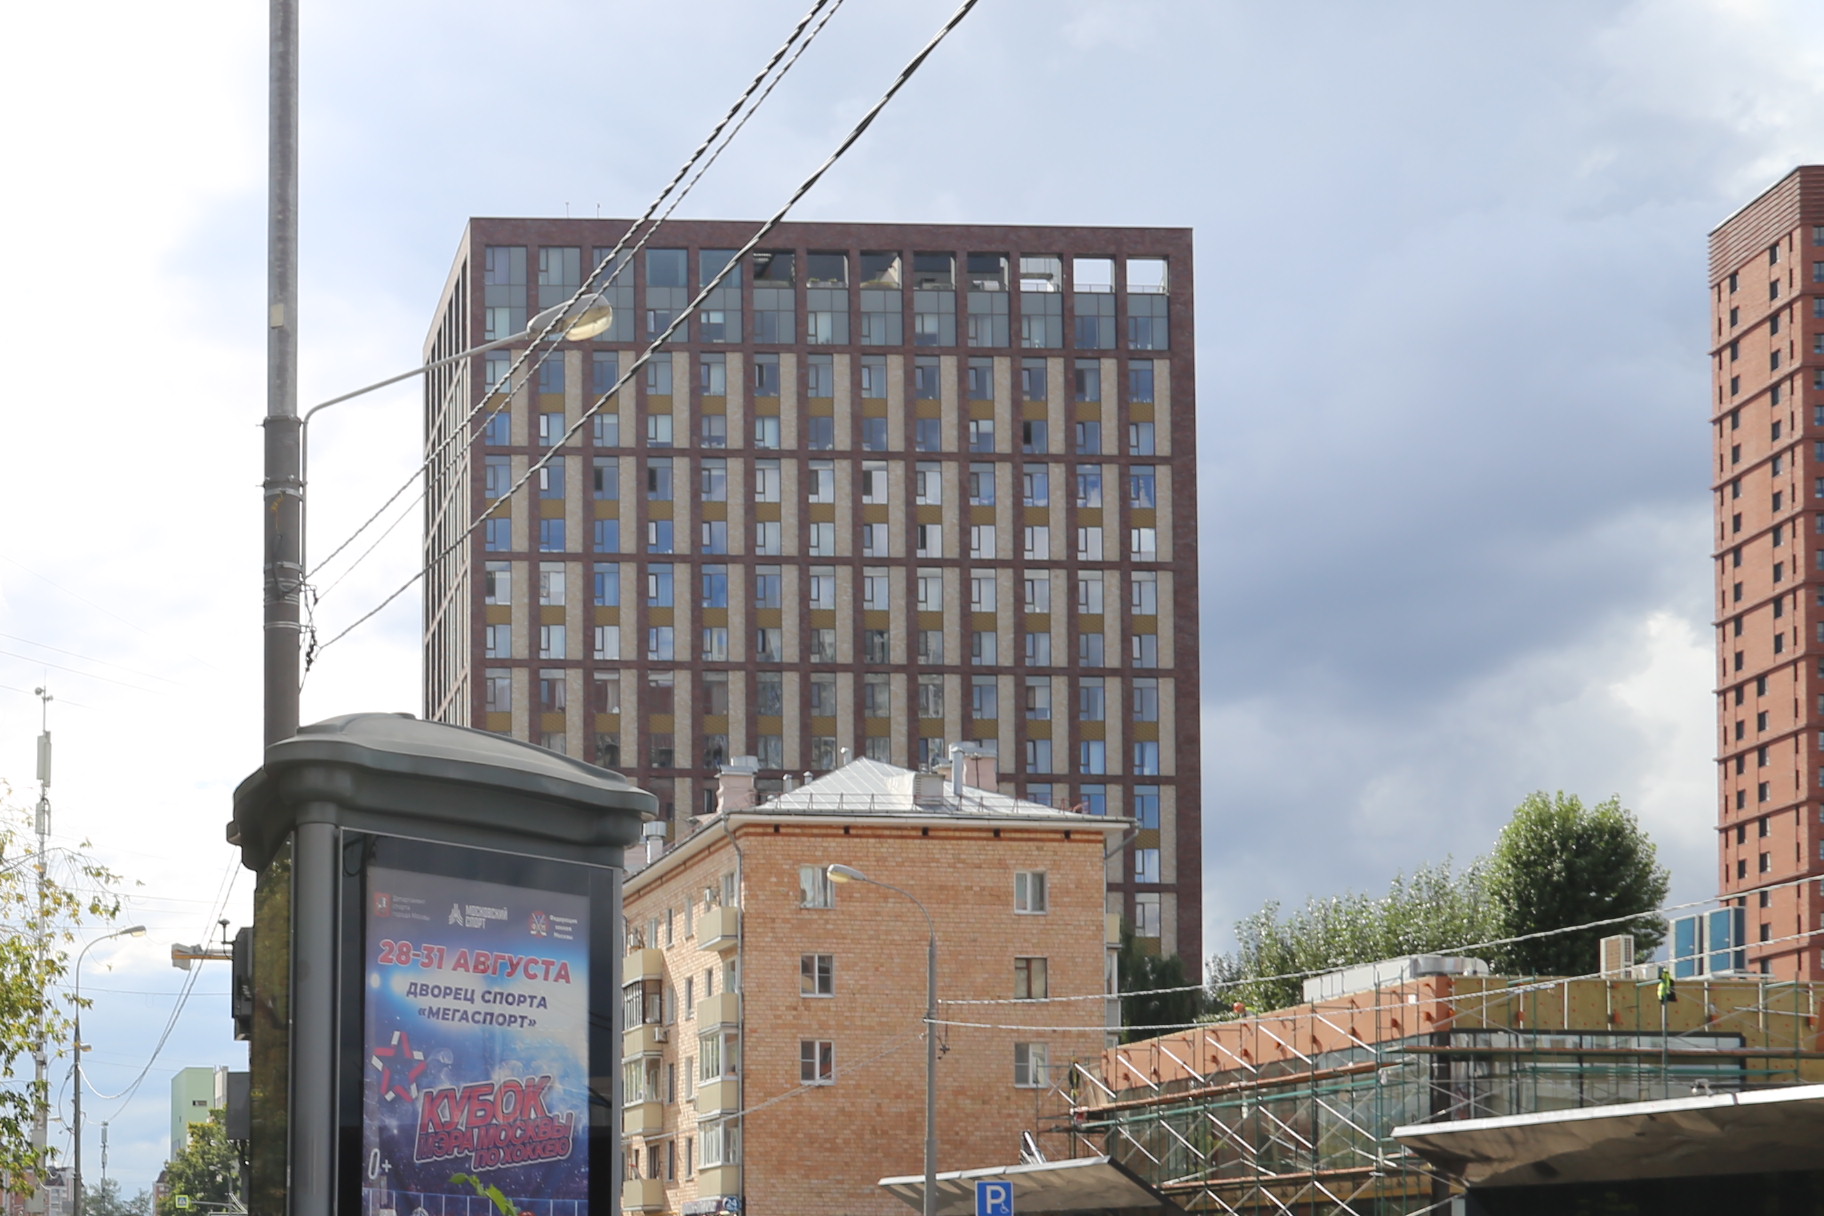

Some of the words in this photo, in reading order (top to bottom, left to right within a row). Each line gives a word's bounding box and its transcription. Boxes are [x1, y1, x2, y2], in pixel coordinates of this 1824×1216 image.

[378, 939, 447, 970] 28-31
[451, 948, 572, 984] АВГУСТА
[406, 981, 475, 1004] ДВОРЕЦ
[481, 989, 548, 1010] СПОРТА
[418, 1006, 537, 1028] «МЕГАСПОРТ»
[419, 1076, 551, 1134] КУБОК
[415, 1128, 475, 1160] МЭРА
[474, 1112, 573, 1151] МОСКВЫ
[368, 1148, 392, 1180] 0+
[474, 1147, 501, 1170] ПО
[500, 1137, 570, 1166] ХОККЕЮ
